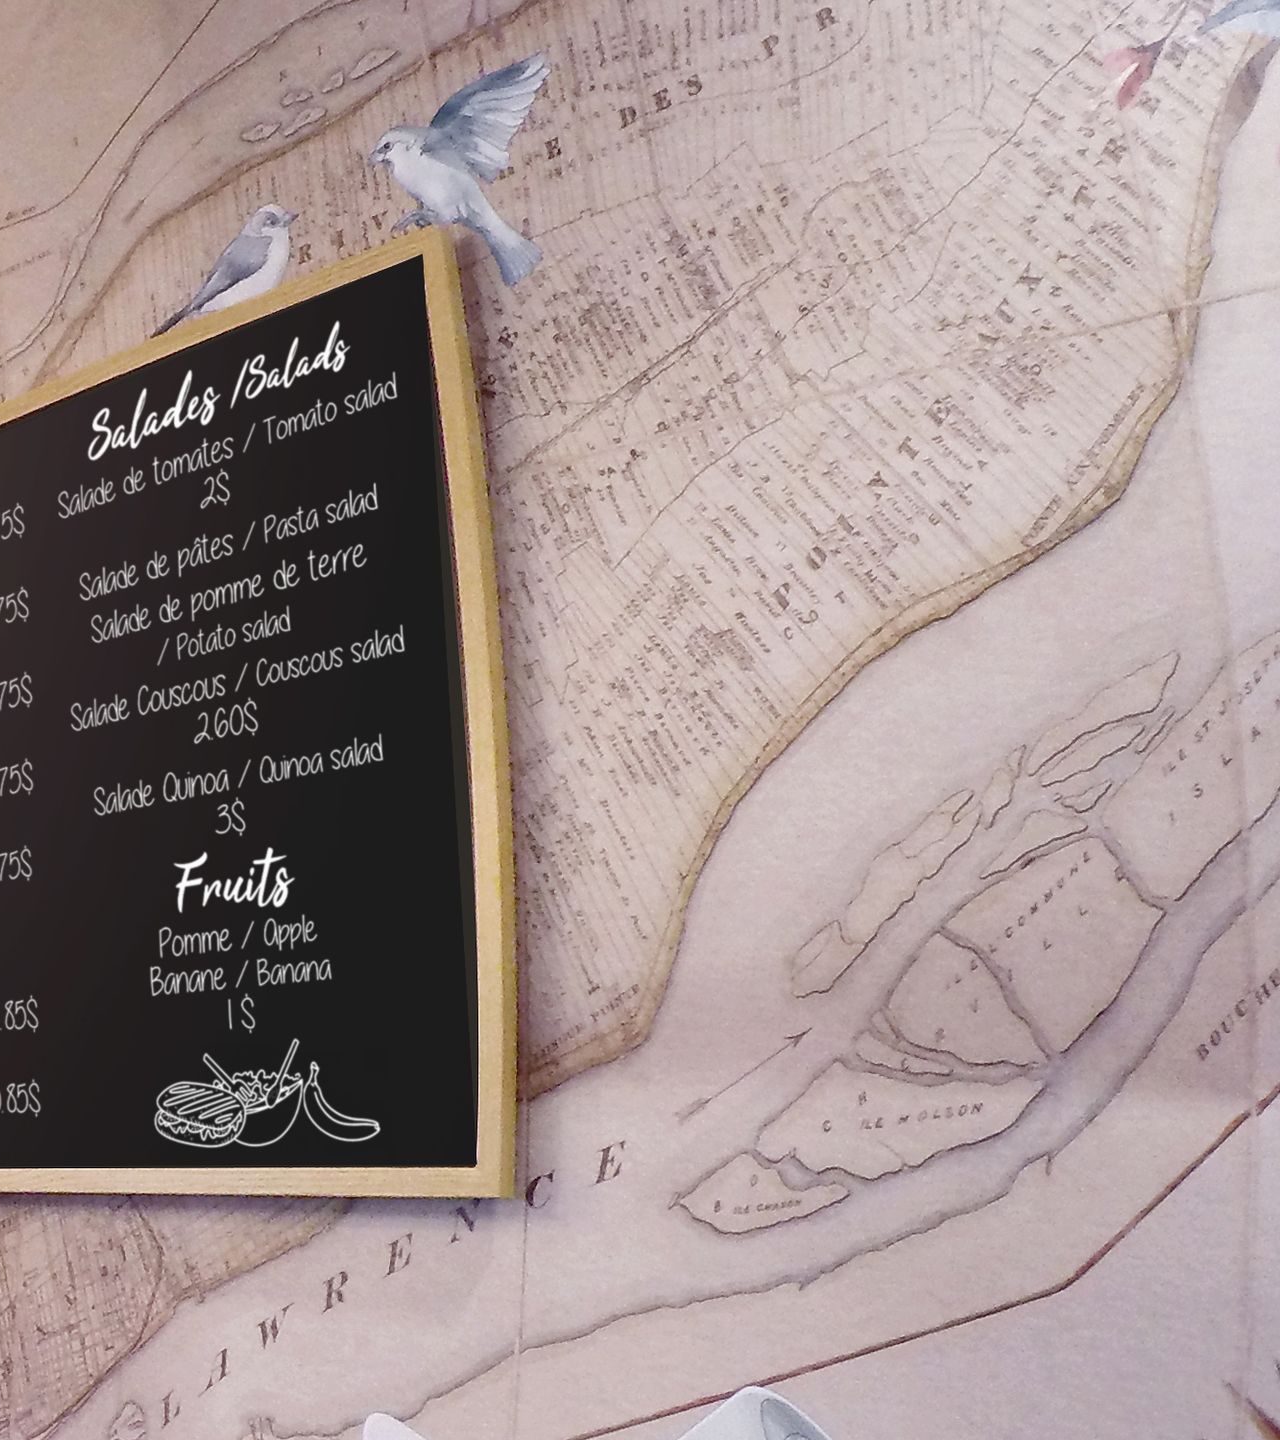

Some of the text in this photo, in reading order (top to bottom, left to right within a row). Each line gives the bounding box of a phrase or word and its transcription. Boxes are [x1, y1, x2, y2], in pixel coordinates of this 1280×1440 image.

[57, 370, 398, 520] Salade de tomates Tomato salad
[87, 369, 222, 462] Salades
[199, 467, 231, 510] 2$
[78, 482, 379, 602] Salade de pâtes Pasta salad
[90, 543, 368, 644] Salade de pomme de terre
[176, 604, 292, 661] Potato salad
[70, 623, 406, 732] Salade Couscous Couscous salad
[93, 732, 384, 817] Salade Quinoa Quinoa salad
[214, 796, 247, 837] 3$
[173, 846, 296, 914] Fruits
[158, 913, 319, 959] Pomme Apple
[149, 957, 333, 997] Banane Banana
